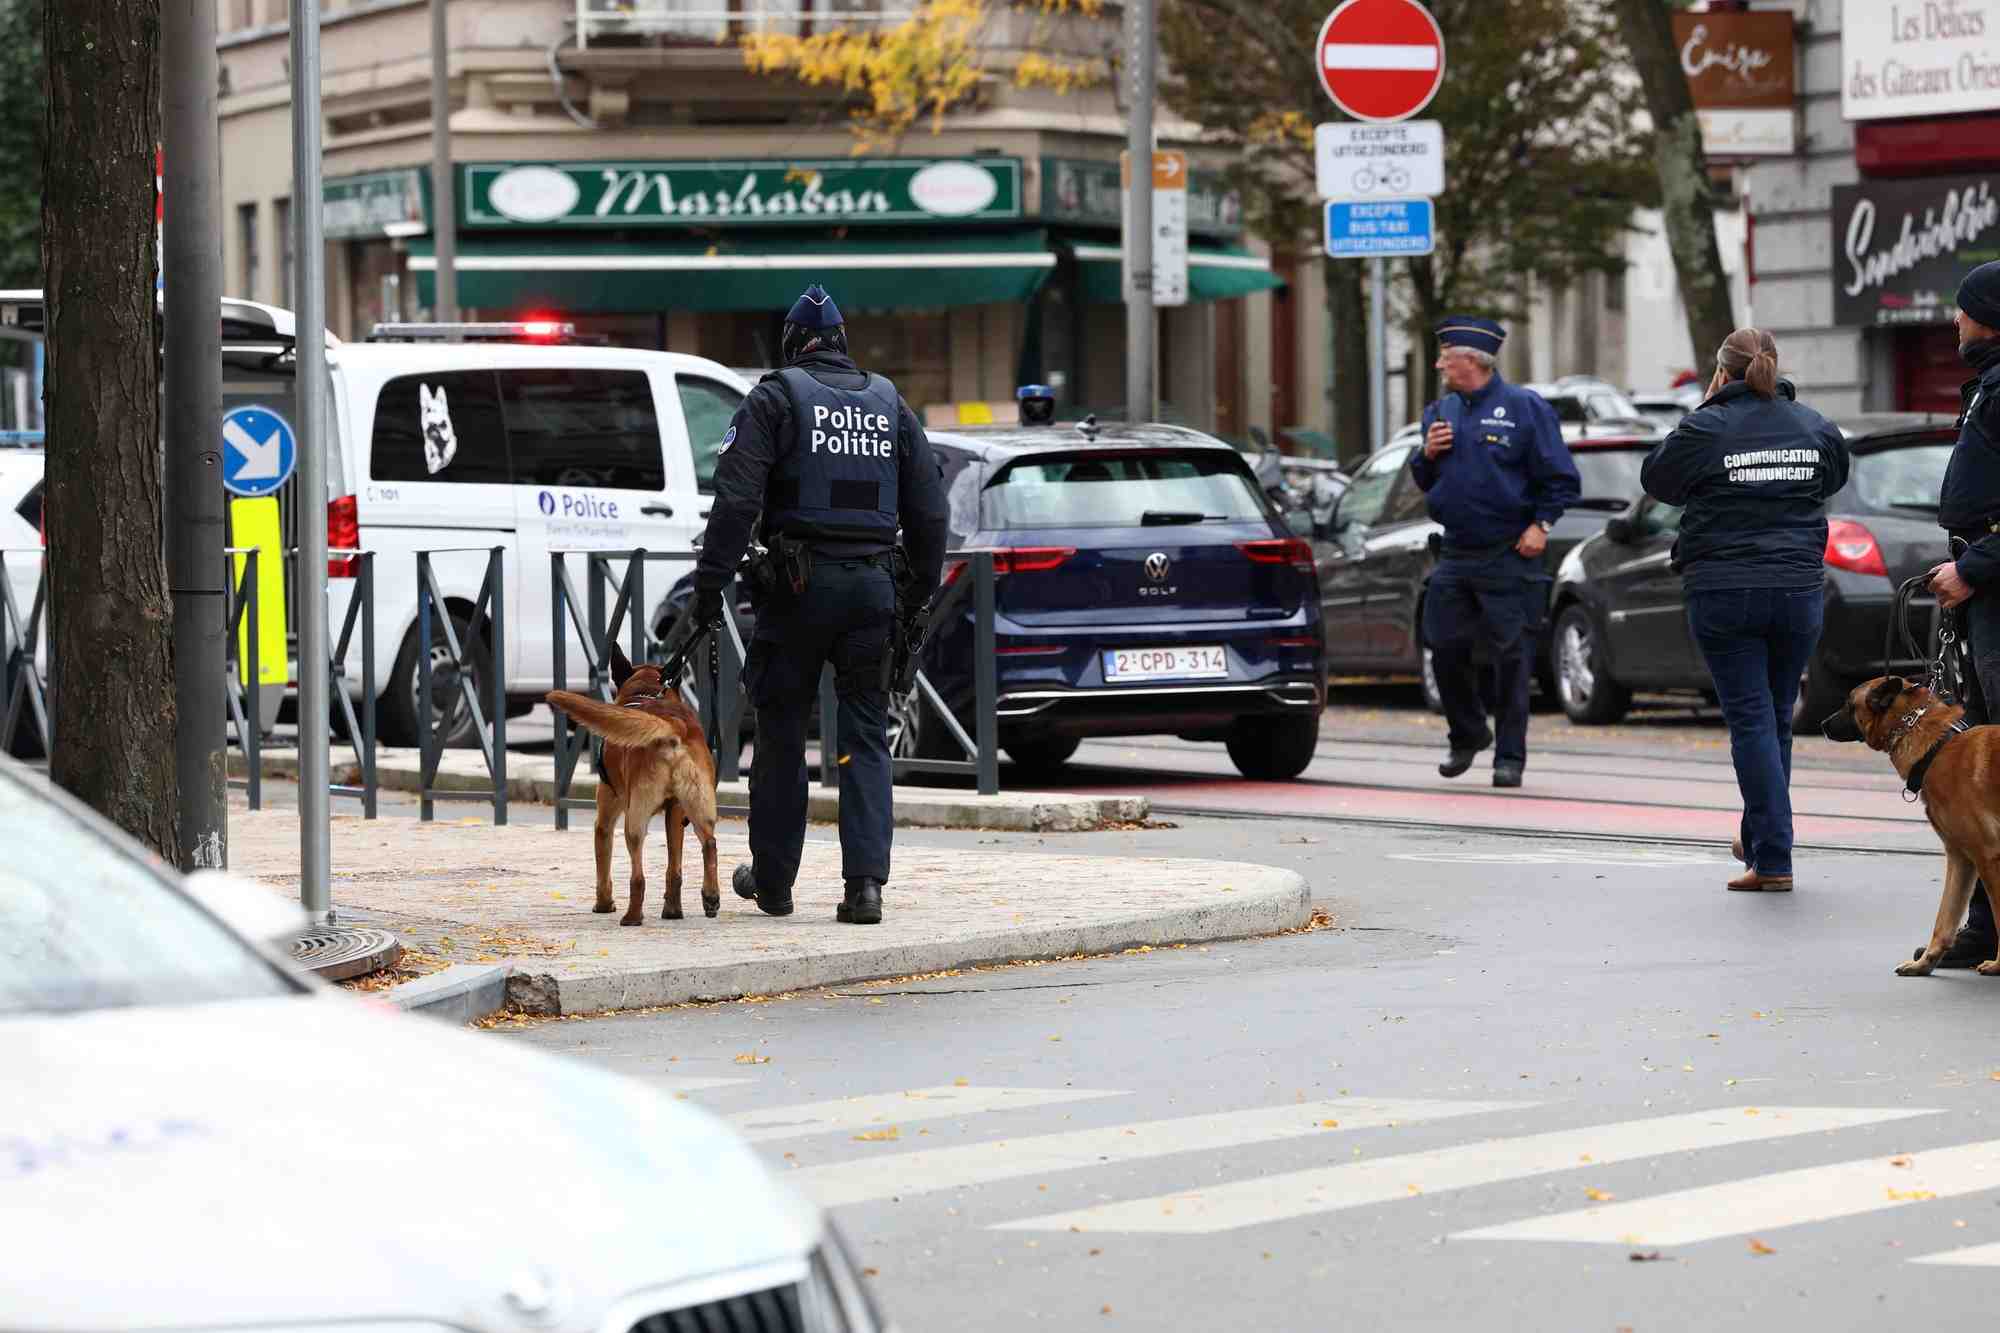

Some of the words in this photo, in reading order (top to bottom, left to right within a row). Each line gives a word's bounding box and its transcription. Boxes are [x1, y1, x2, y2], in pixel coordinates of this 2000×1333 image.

[813, 405, 890, 432] Police
[811, 429, 893, 458] Politie
[562, 493, 619, 519] Police
[1138, 586, 1177, 597] GOLF
